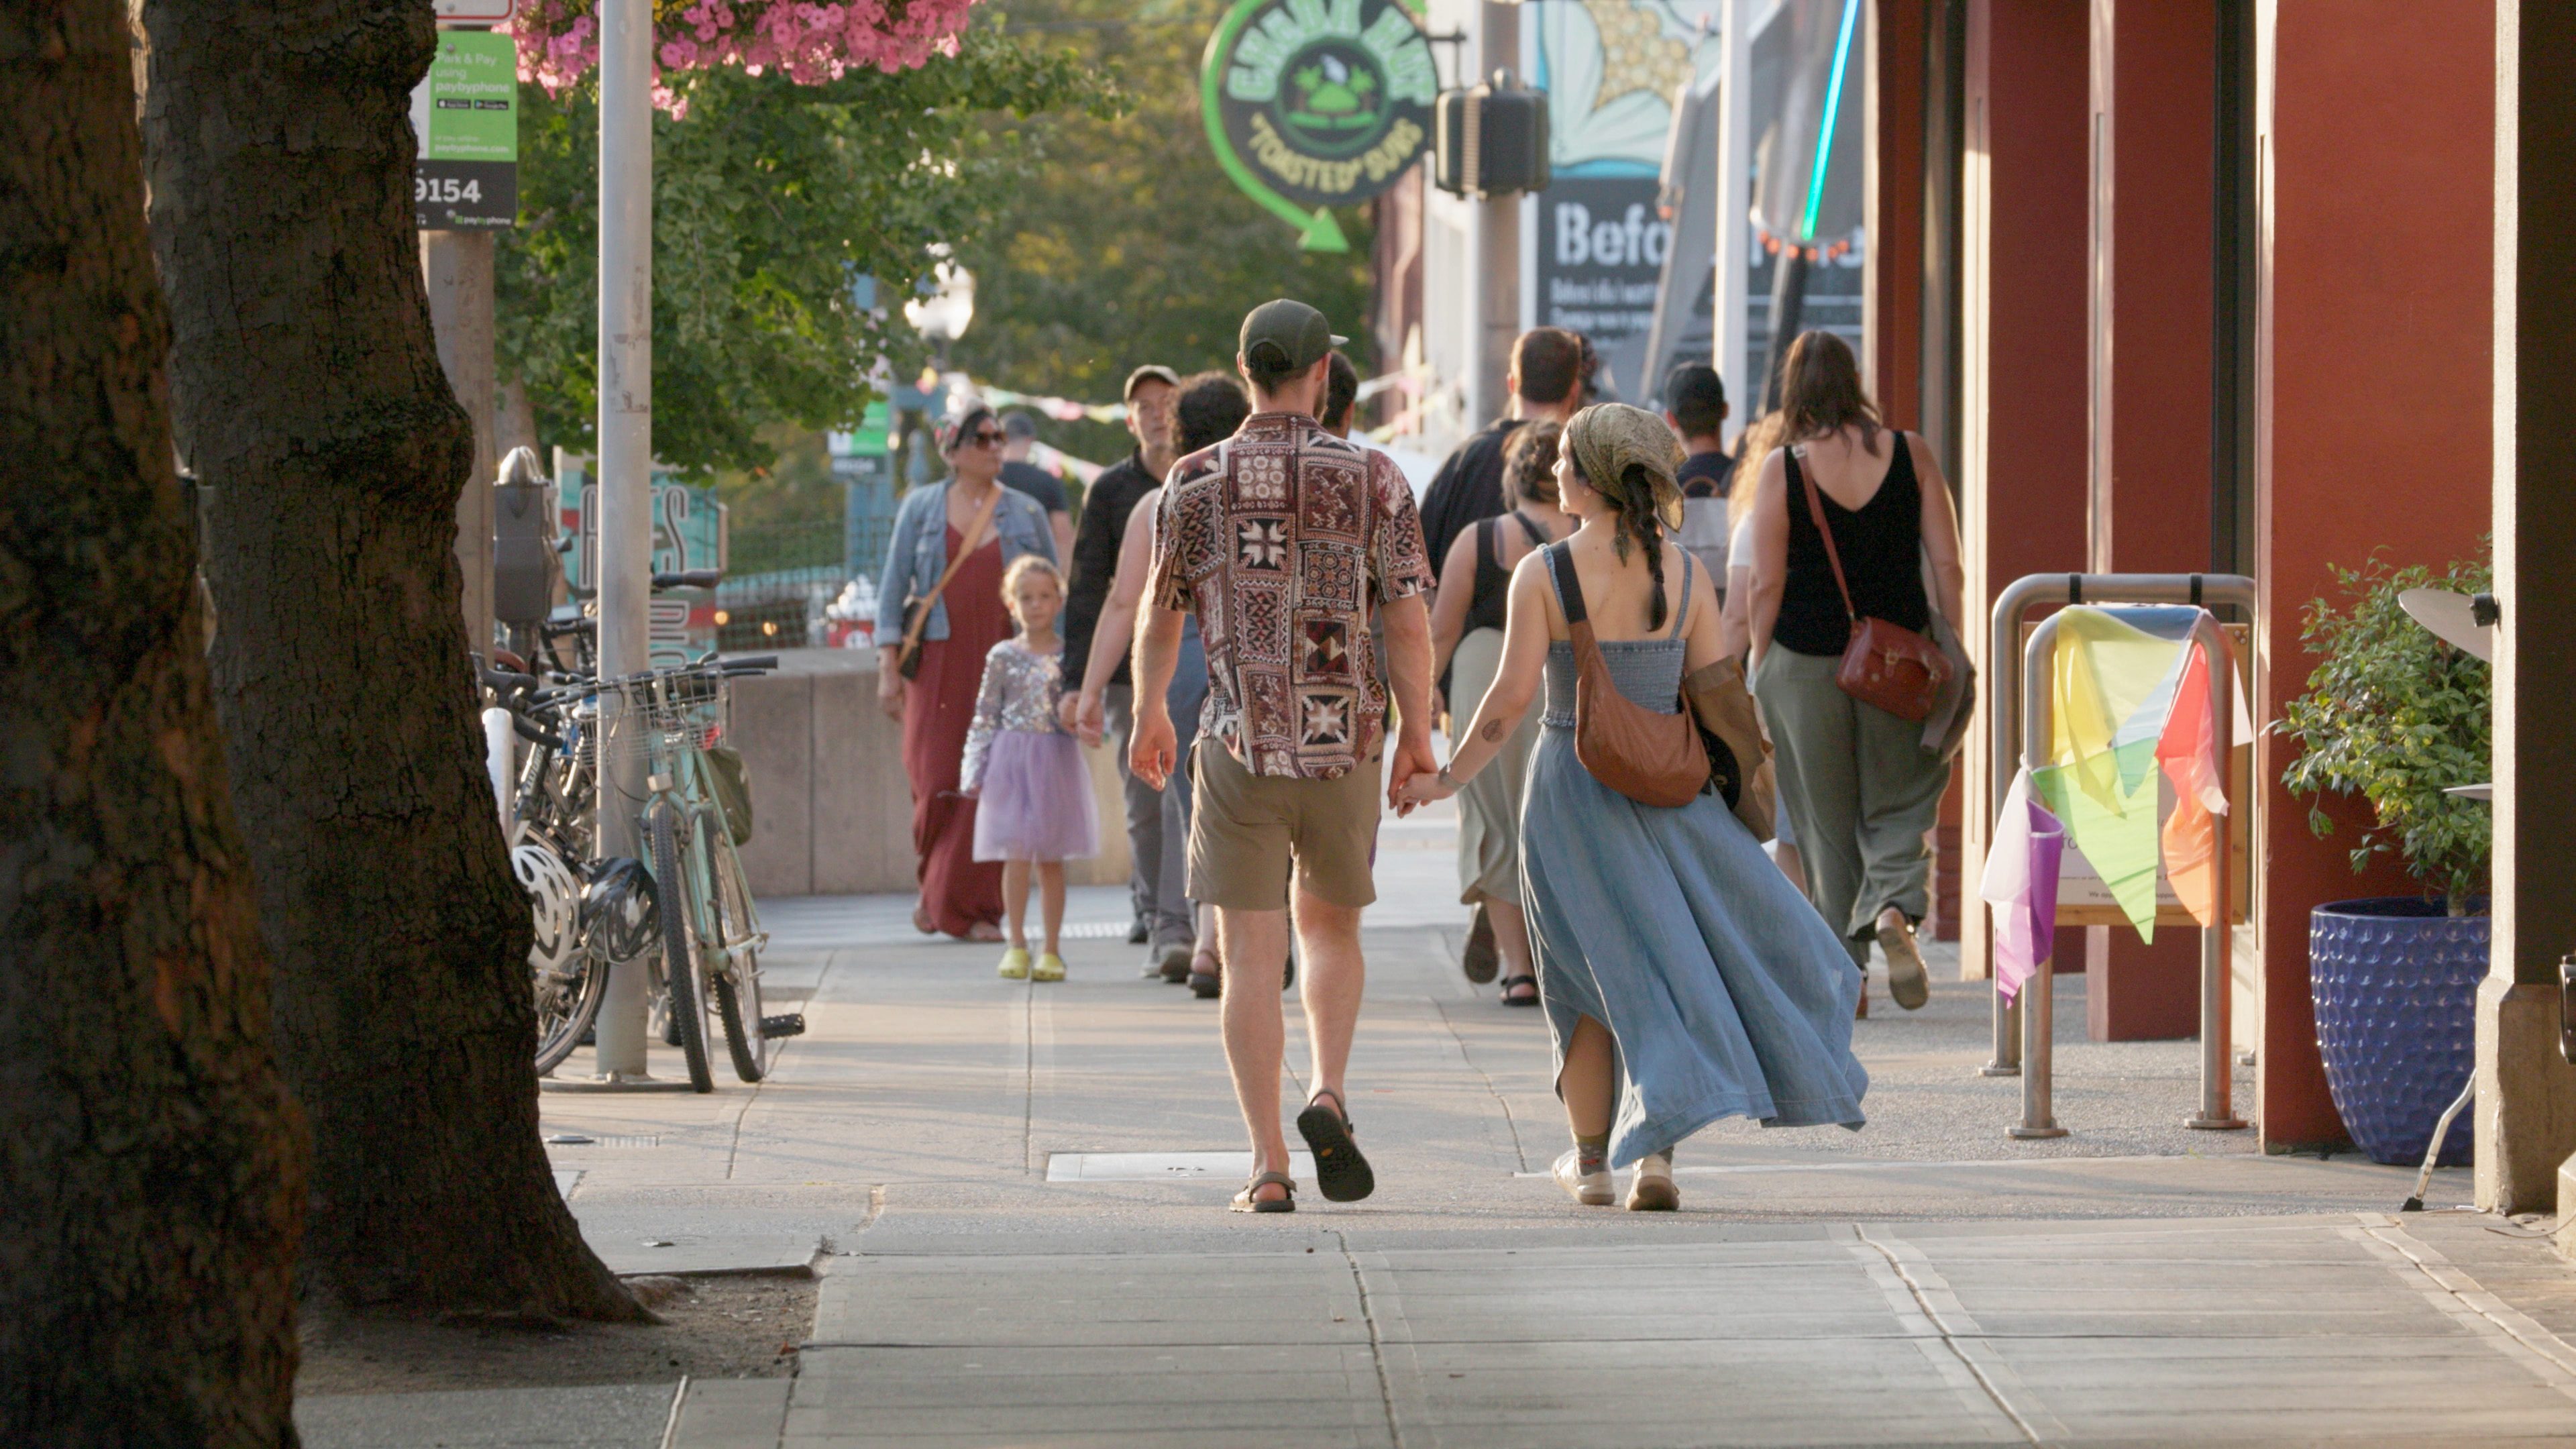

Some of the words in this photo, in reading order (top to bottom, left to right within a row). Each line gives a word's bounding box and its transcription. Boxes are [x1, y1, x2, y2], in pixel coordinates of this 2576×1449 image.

[435, 52, 462, 64] Park
[464, 53, 472, 64] &
[475, 53, 496, 67] Pay
[436, 68, 467, 80] using
[436, 81, 510, 94] paybyphone
[464, 216, 511, 225] paybyphone
[1555, 202, 1673, 266] Befo
